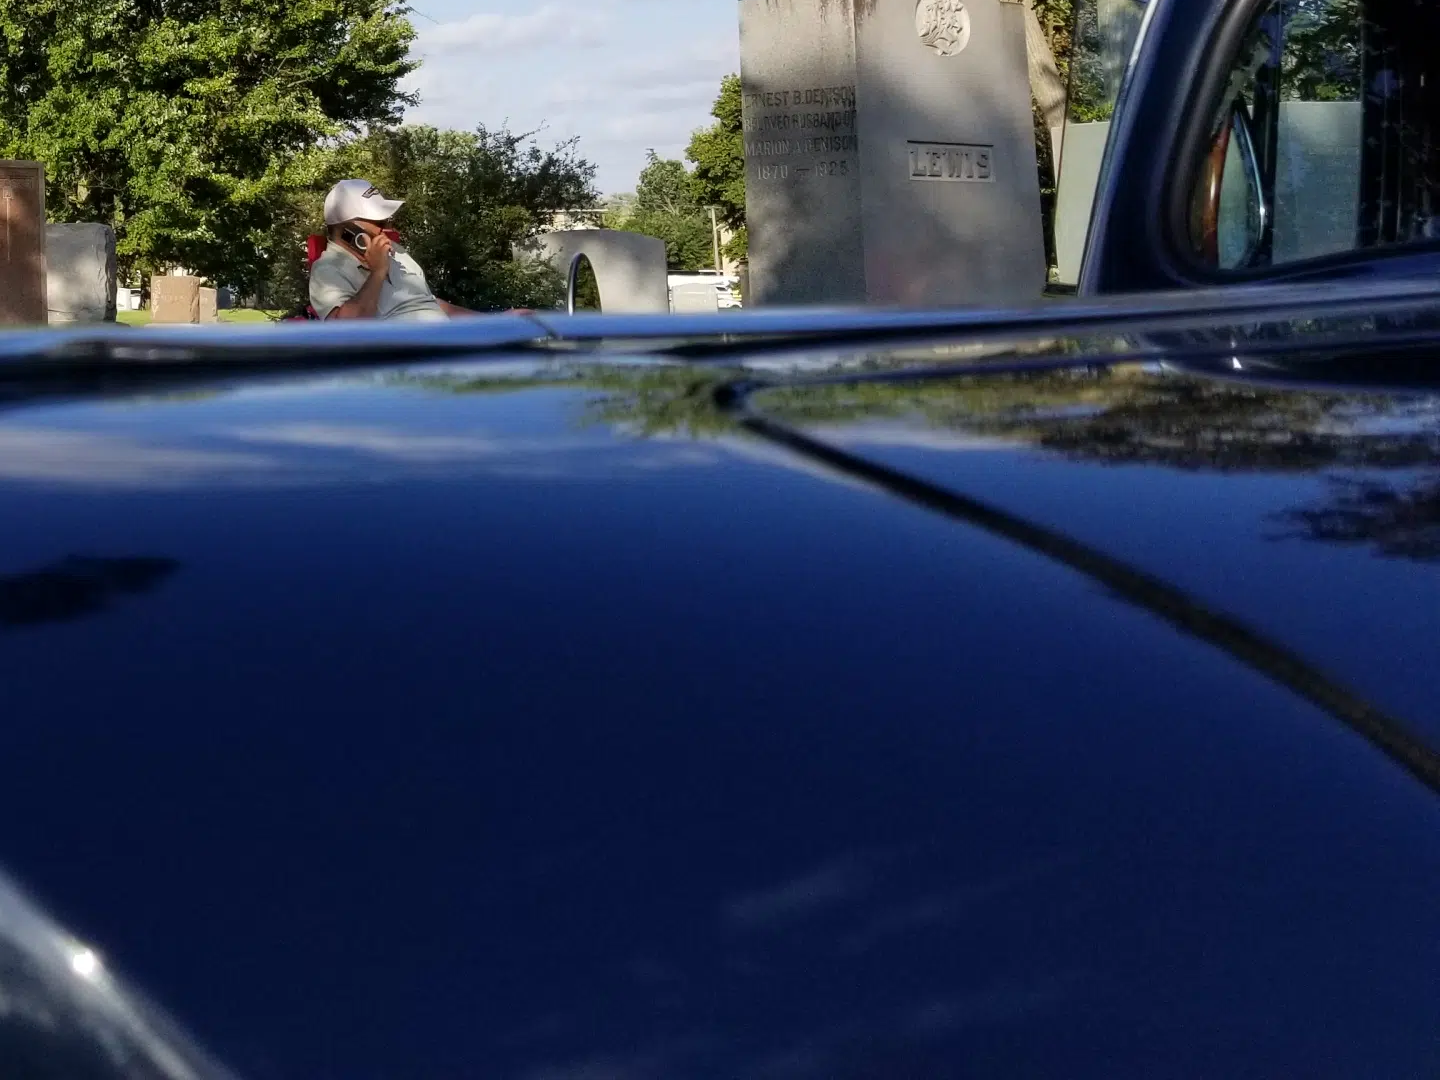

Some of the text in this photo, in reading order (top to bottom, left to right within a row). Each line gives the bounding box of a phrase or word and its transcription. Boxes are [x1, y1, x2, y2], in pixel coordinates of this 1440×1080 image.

[744, 91, 789, 109] ERNEST
[744, 115, 791, 133] BELOVED
[745, 139, 790, 156] MARION
[757, 164, 788, 180] 1870
[910, 151, 990, 179] LEWIS
